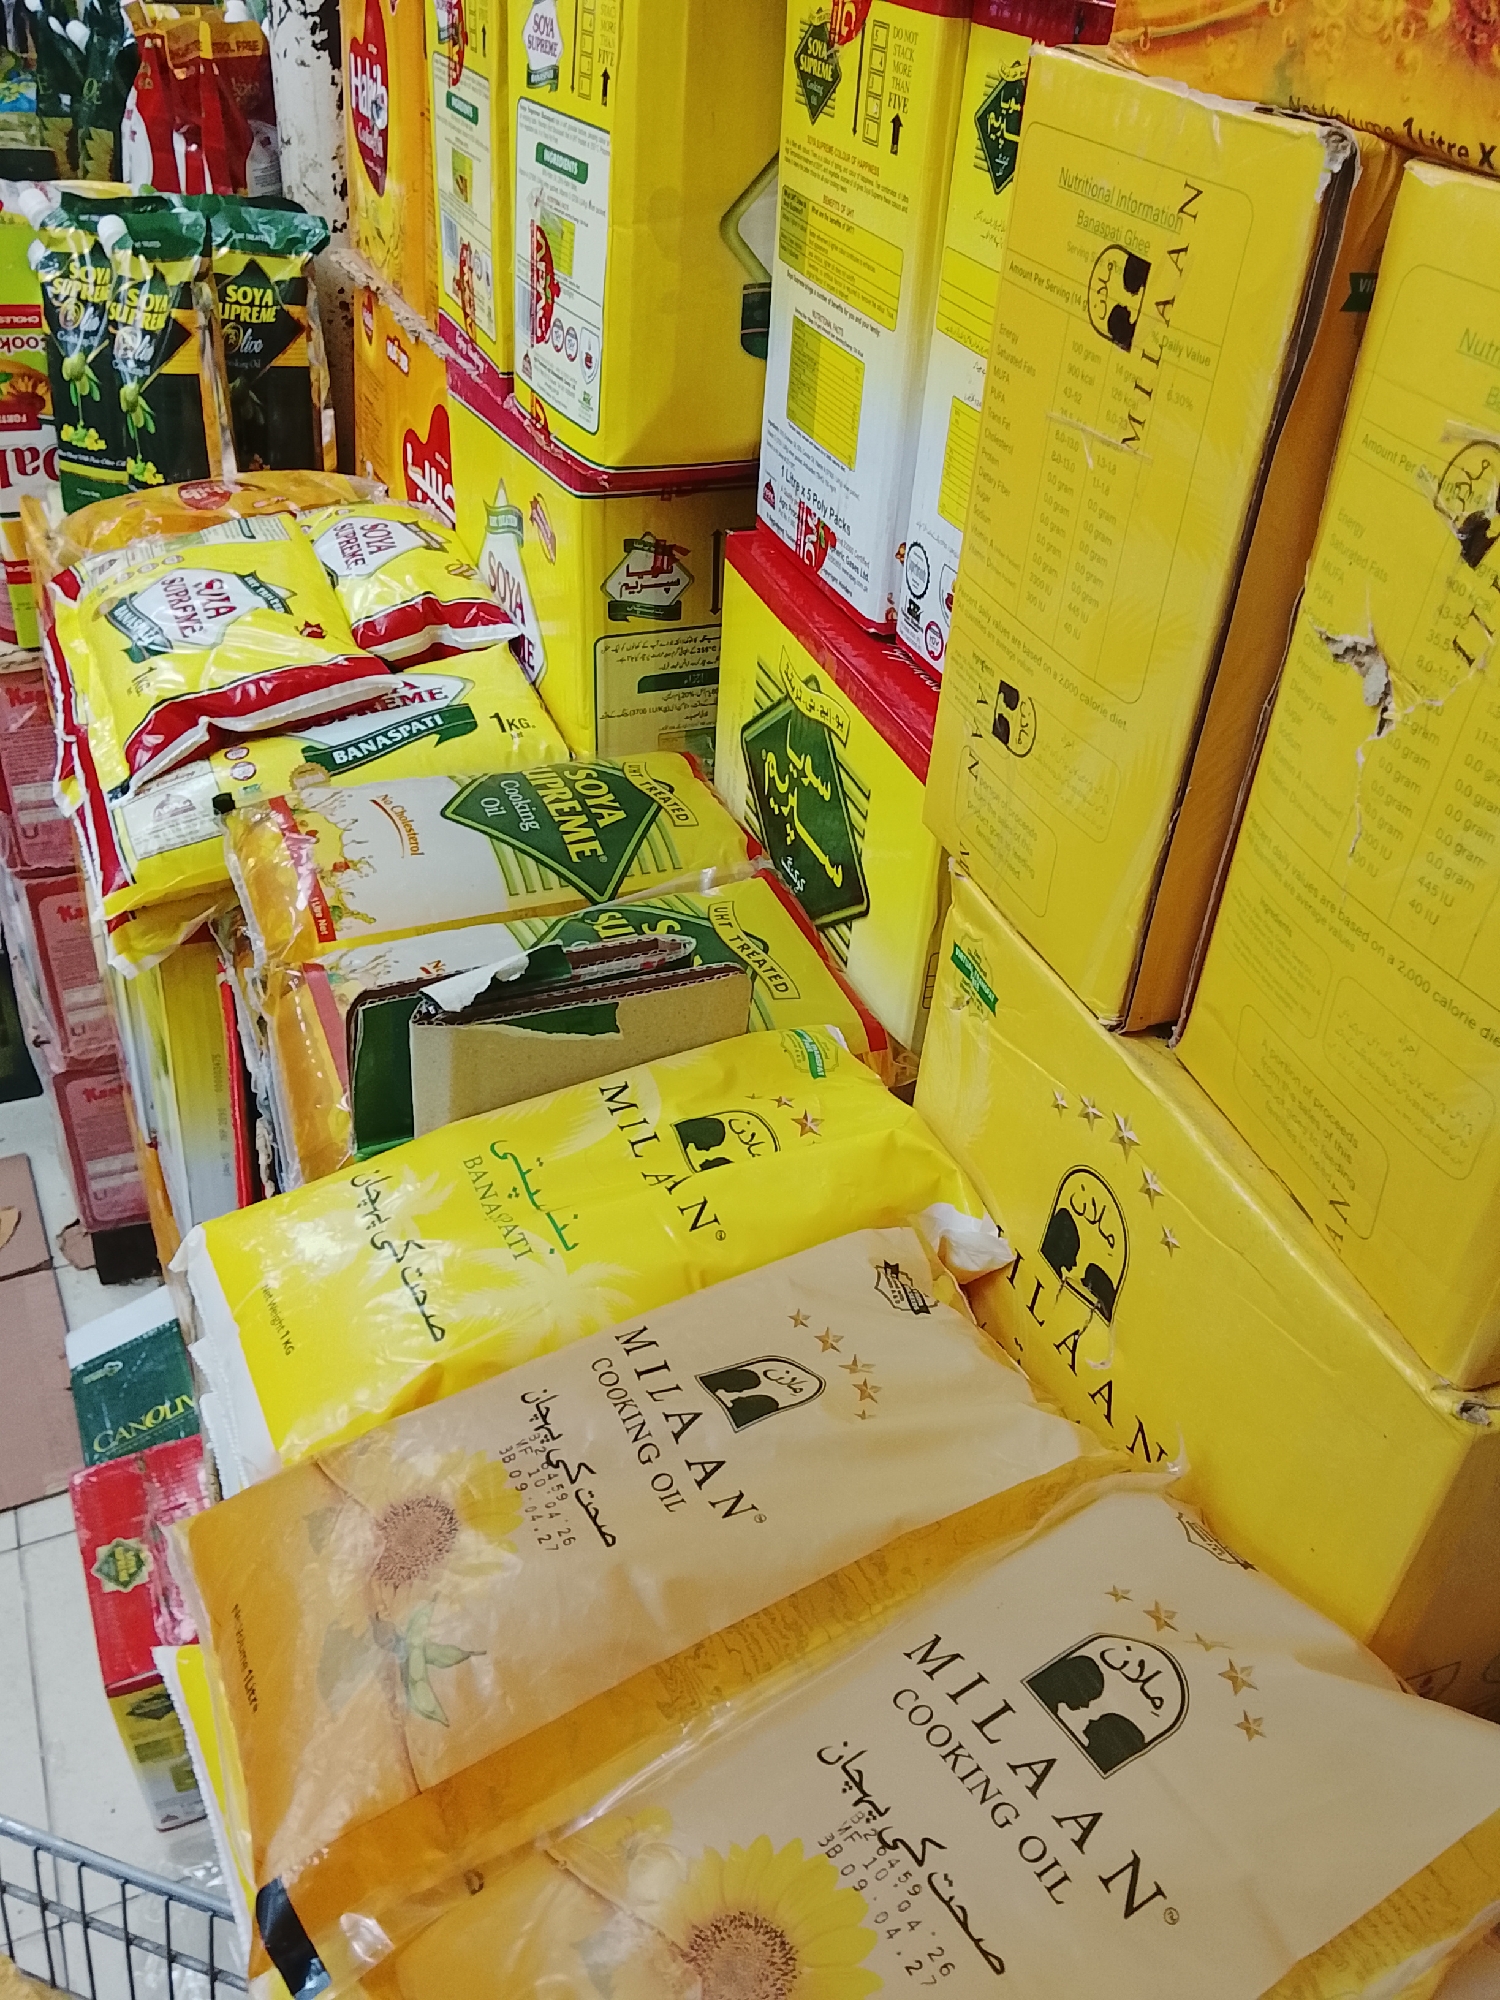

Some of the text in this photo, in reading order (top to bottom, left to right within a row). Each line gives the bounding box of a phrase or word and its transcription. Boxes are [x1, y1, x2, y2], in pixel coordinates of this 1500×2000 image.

[533, 13, 555, 39] SOYA
[892, 26, 919, 46] DO NOT
[527, 34, 558, 58] SUPREME
[597, 48, 615, 67] FIVE
[807, 37, 829, 60] SOYA
[892, 43, 915, 63] STACK
[800, 54, 834, 82] SUPREME
[891, 76, 910, 94] THAN
[892, 60, 913, 79] MORE
[888, 91, 909, 114] FIVE
[1058, 166, 1184, 231] Nutritional Information
[1075, 208, 1151, 254] Banaspati Ghee
[226, 285, 274, 306] SOYA
[1009, 260, 1071, 303] Amount Per Serving
[218, 303, 277, 323] UPREME
[999, 322, 1021, 345] Energy
[1160, 334, 1212, 368] Daily Value
[993, 365, 1010, 385] MUFA
[996, 345, 1022, 371] Saturated
[1066, 362, 1095, 387] 900 kcal
[990, 386, 1006, 405] PUFA
[984, 428, 1013, 454] Cholesterol
[1362, 433, 1418, 475] Amount Per
[806, 489, 812, 502] 5
[812, 492, 828, 519] Poly
[828, 505, 851, 537] Packs
[1336, 507, 1367, 540] Energy
[360, 522, 398, 555] SOYA
[1320, 557, 1345, 586] MUFA
[1328, 532, 1390, 584] Saturated Fats
[162, 576, 204, 639] SUPREME
[1313, 581, 1335, 607] PUFA
[992, 616, 1011, 639] values
[1022, 641, 1043, 668] based
[1058, 675, 1079, 696] 2,000
[1079, 691, 1108, 718] calorie
[332, 713, 445, 765] BANASPATI
[787, 717, 832, 802] سویا
[480, 796, 507, 819] Oil
[500, 779, 541, 832] Cooking
[563, 766, 627, 829] SOYA
[631, 763, 690, 822] UHT TREATED
[376, 793, 426, 856] No Cholesterol
[523, 767, 602, 863] UPREME
[764, 748, 844, 889] سپریم
[1463, 817, 1496, 846] gram
[1454, 842, 1489, 869] gram
[1416, 875, 1456, 908] 445 IU
[1443, 864, 1476, 894] gram
[1408, 898, 1441, 927] 40 IU
[712, 906, 791, 995] UHT TREATED
[1291, 866, 1478, 1030] values based 2,000 calorie
[1313, 1096, 1359, 1149] proceeds
[462, 1154, 534, 1261] BANASPATI
[351, 1169, 446, 1342] صحت کی پہچان
[264, 1296, 285, 1333] Weight
[995, 1224, 1169, 1464] ILAAN
[591, 1356, 688, 1514] COOKING OIL
[613, 1325, 759, 1522] MILAAN
[520, 1387, 618, 1549] صحت کی پہچان
[903, 1633, 1168, 1921] MILAAN
[892, 1688, 1073, 1906] COOKING OIL
[816, 1740, 1006, 1976] صحت کی پہچان
